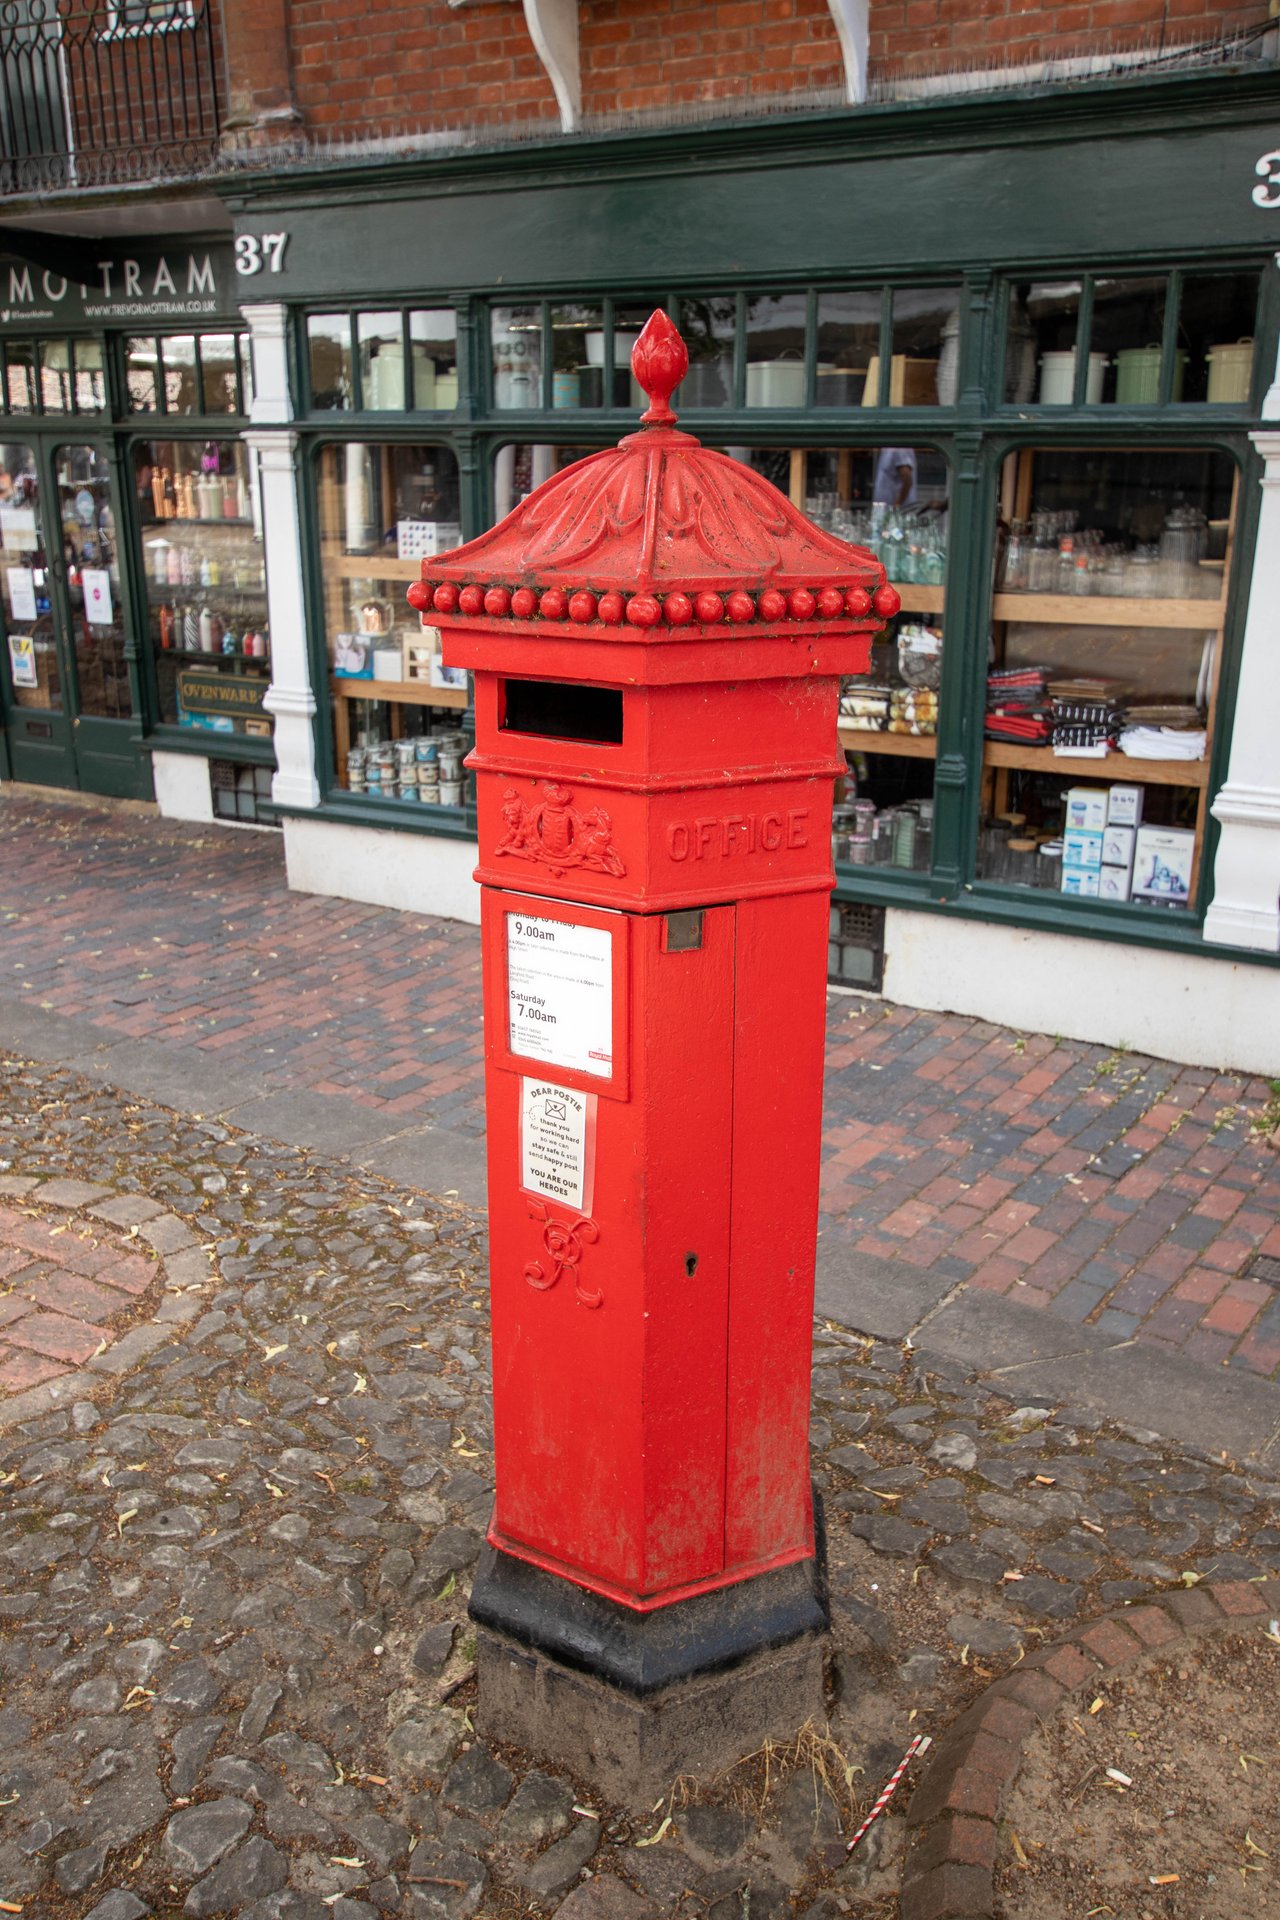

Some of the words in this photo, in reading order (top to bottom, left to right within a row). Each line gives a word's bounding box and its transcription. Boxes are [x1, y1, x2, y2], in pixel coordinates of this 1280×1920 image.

[235, 232, 286, 275] 37
[667, 808, 809, 862] OFFICE
[515, 921, 555, 941] 9.00am
[510, 990, 546, 1007] Saturday
[517, 1003, 557, 1024] 7.00am
[530, 1087, 552, 1098] DEAR
[553, 1089, 582, 1112] POSTIE
[540, 1118, 557, 1128] thank
[540, 1127, 565, 1140] working
[565, 1134, 580, 1145] hard
[528, 1150, 544, 1160] send
[544, 1154, 563, 1167] happy
[532, 1142, 545, 1152] stay
[546, 1147, 560, 1156] safe
[566, 1154, 578, 1162] still
[530, 1167, 546, 1178] YOU
[546, 1173, 562, 1184] ARE
[562, 1179, 578, 1190] OUR
[539, 1180, 569, 1196] HEROES
